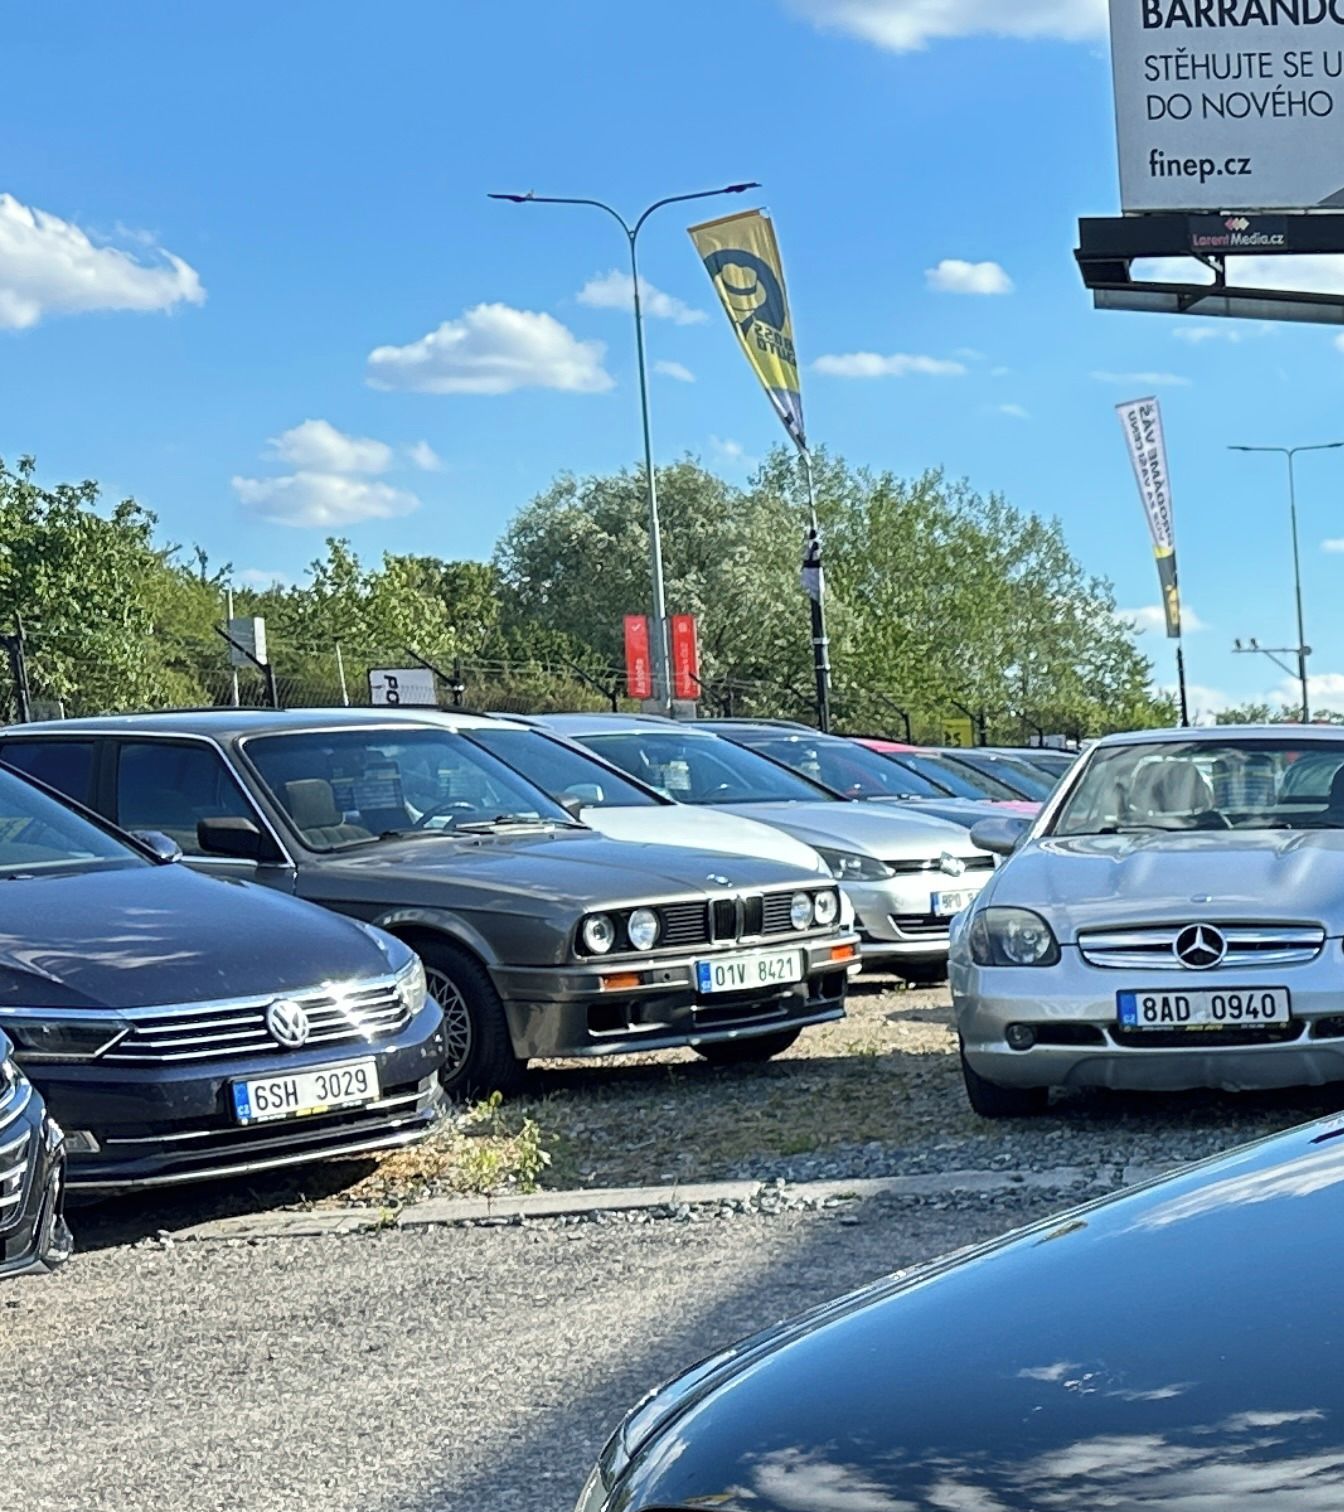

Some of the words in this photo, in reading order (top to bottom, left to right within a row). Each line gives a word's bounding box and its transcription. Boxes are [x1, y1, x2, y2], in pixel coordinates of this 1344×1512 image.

[1144, 47, 1273, 81] STĚHUJTE
[1283, 51, 1313, 78] SE
[1146, 93, 1193, 121] DO
[1203, 84, 1334, 119] NOVÉHO
[1149, 149, 1252, 184] finep.cz
[715, 963, 746, 986] 01V
[758, 957, 793, 982] 8421
[1142, 996, 1191, 1022] 8AD
[1211, 993, 1276, 1020] 0940
[255, 1079, 299, 1111] 6SH
[315, 1068, 368, 1100] 3029
